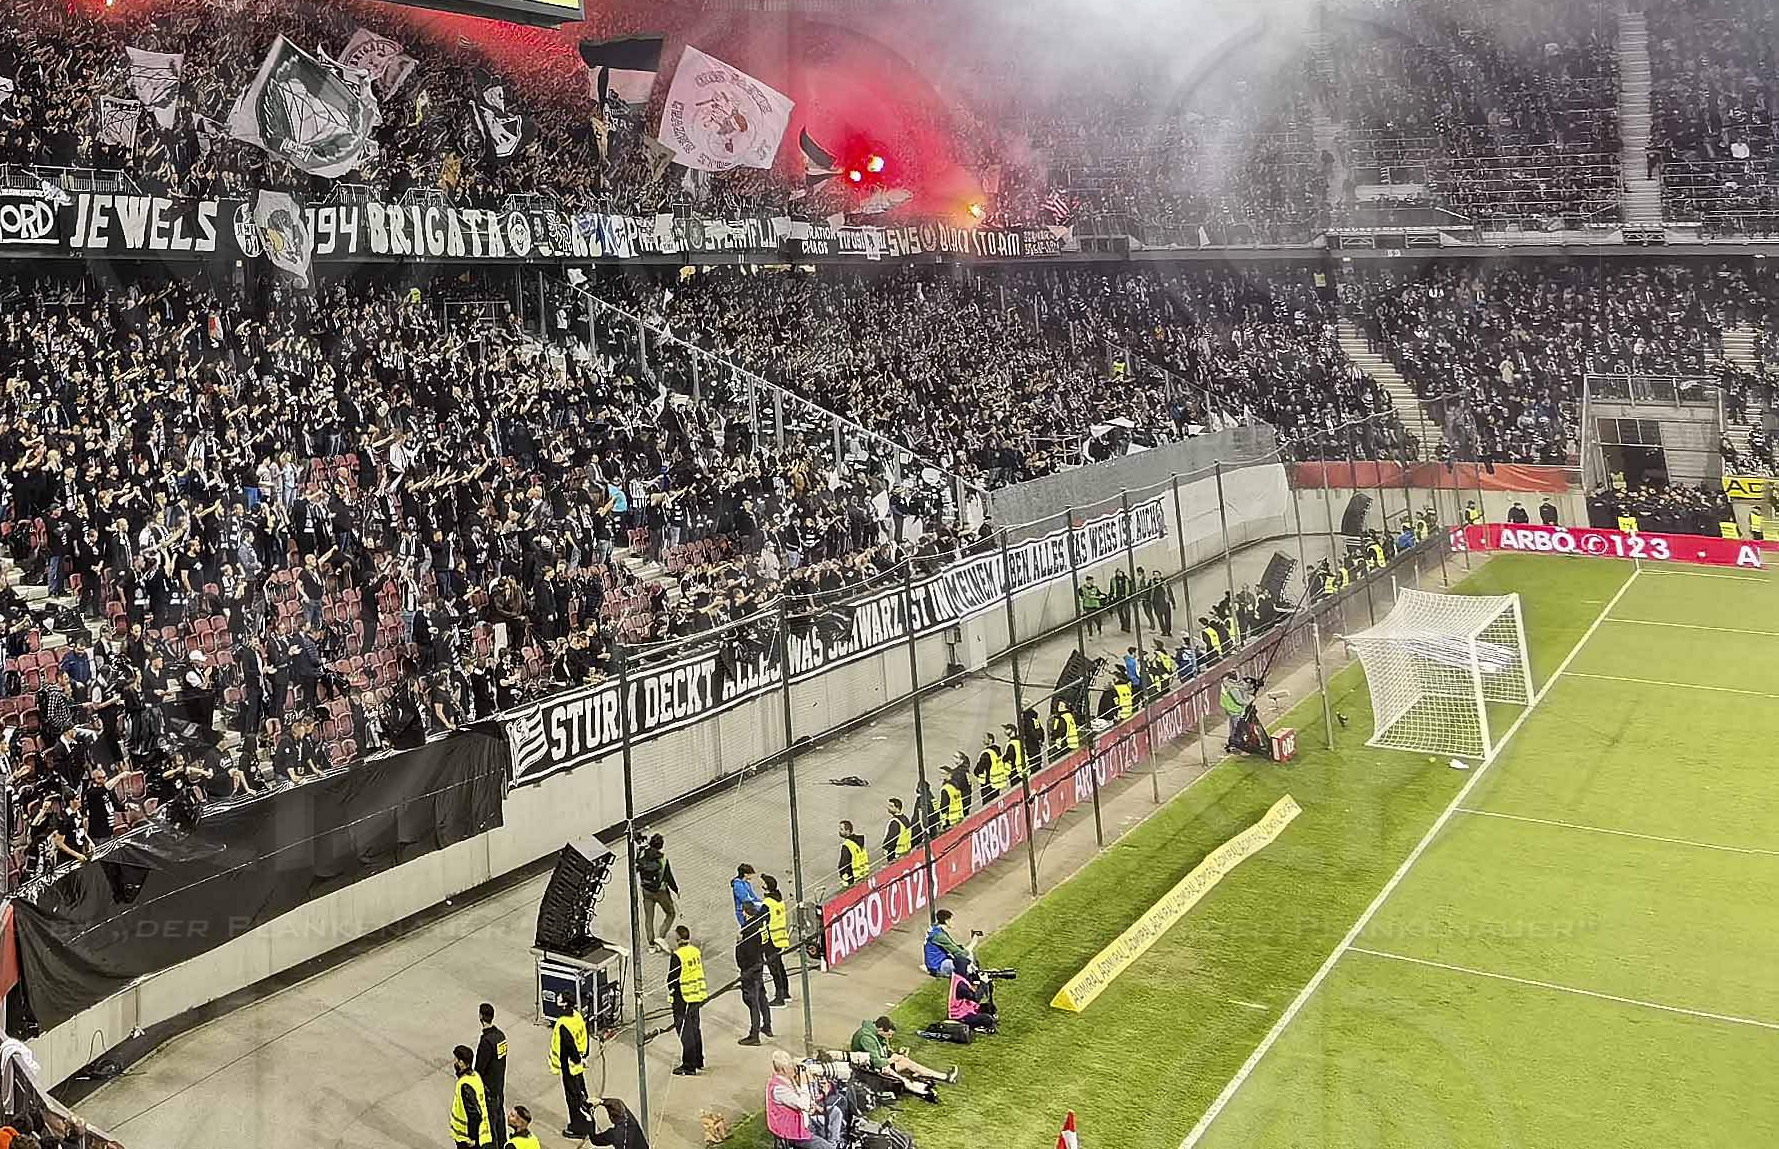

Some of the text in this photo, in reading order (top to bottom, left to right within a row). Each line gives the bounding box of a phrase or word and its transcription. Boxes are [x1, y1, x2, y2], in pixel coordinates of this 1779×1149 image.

[71, 194, 218, 252] JEWELS
[367, 202, 506, 257] BRIGATA
[1500, 524, 1670, 560] ARBÖ 123
[1736, 544, 1761, 568] A
[551, 681, 638, 760] STURM
[644, 660, 716, 727] DECKT
[787, 625, 823, 675] WAS
[972, 800, 1010, 873] ARBÖ
[831, 876, 883, 964] ARBÖ
[1069, 970, 1103, 1006] ADMIRAL
